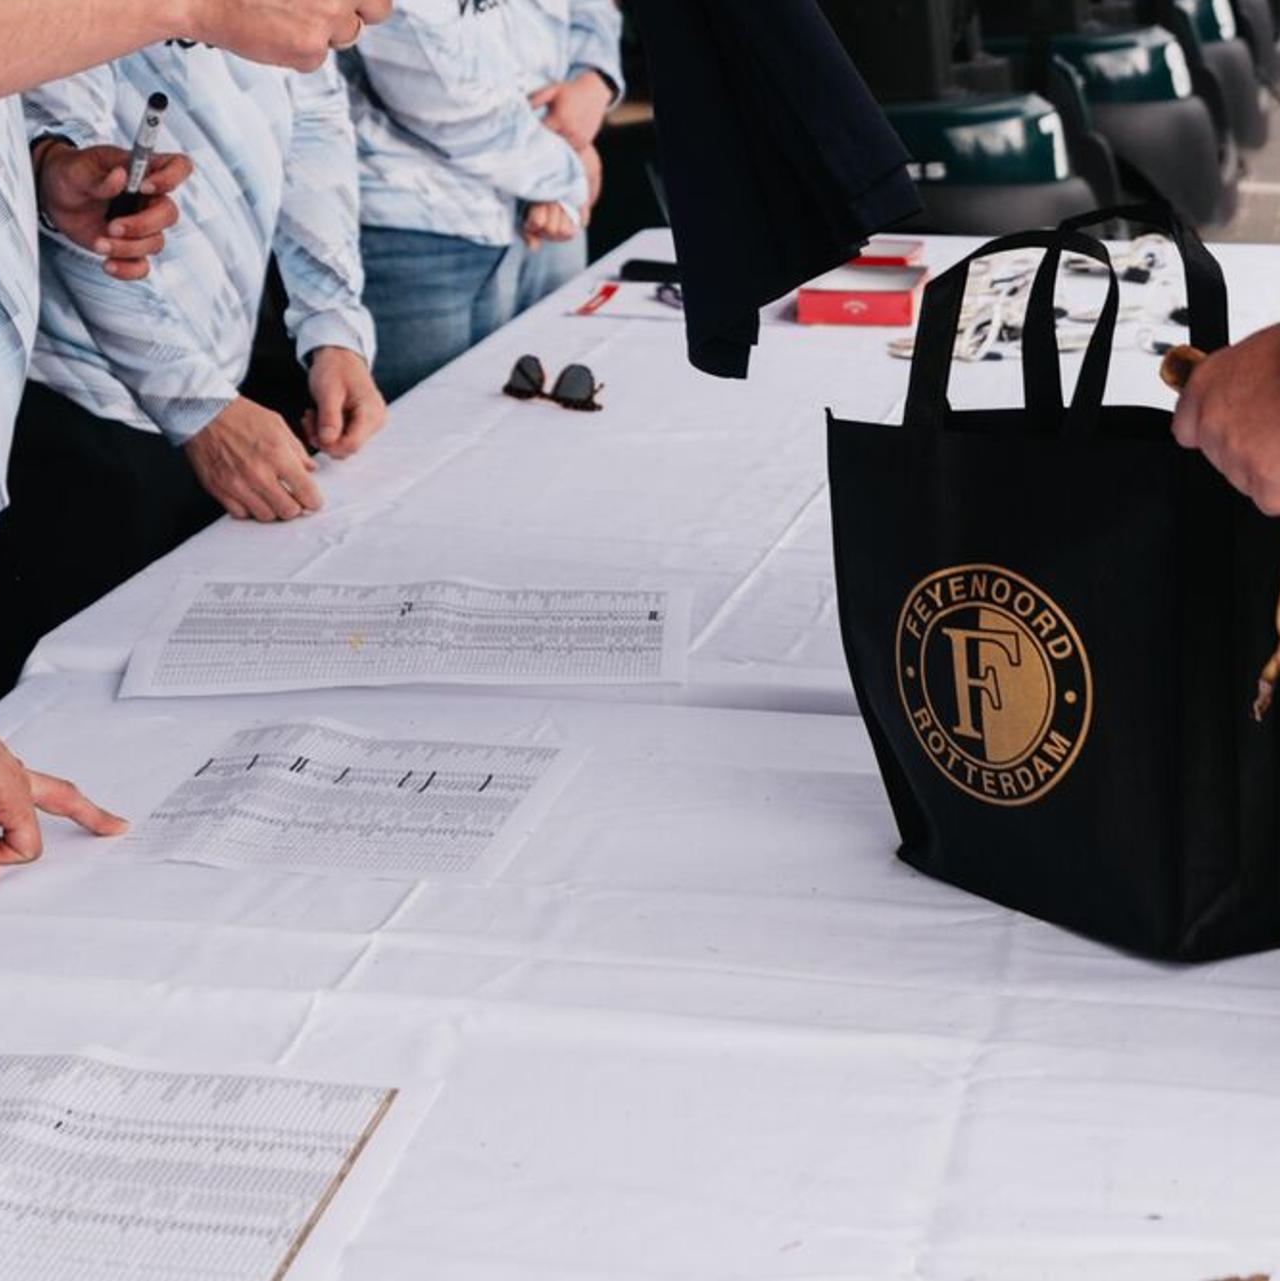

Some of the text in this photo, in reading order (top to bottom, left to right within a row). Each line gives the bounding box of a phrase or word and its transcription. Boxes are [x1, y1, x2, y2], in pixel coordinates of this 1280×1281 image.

[907, 573, 1073, 660] FEYENOORD
[941, 627, 1021, 741] F
[914, 706, 1072, 797] ROTTERDAM
